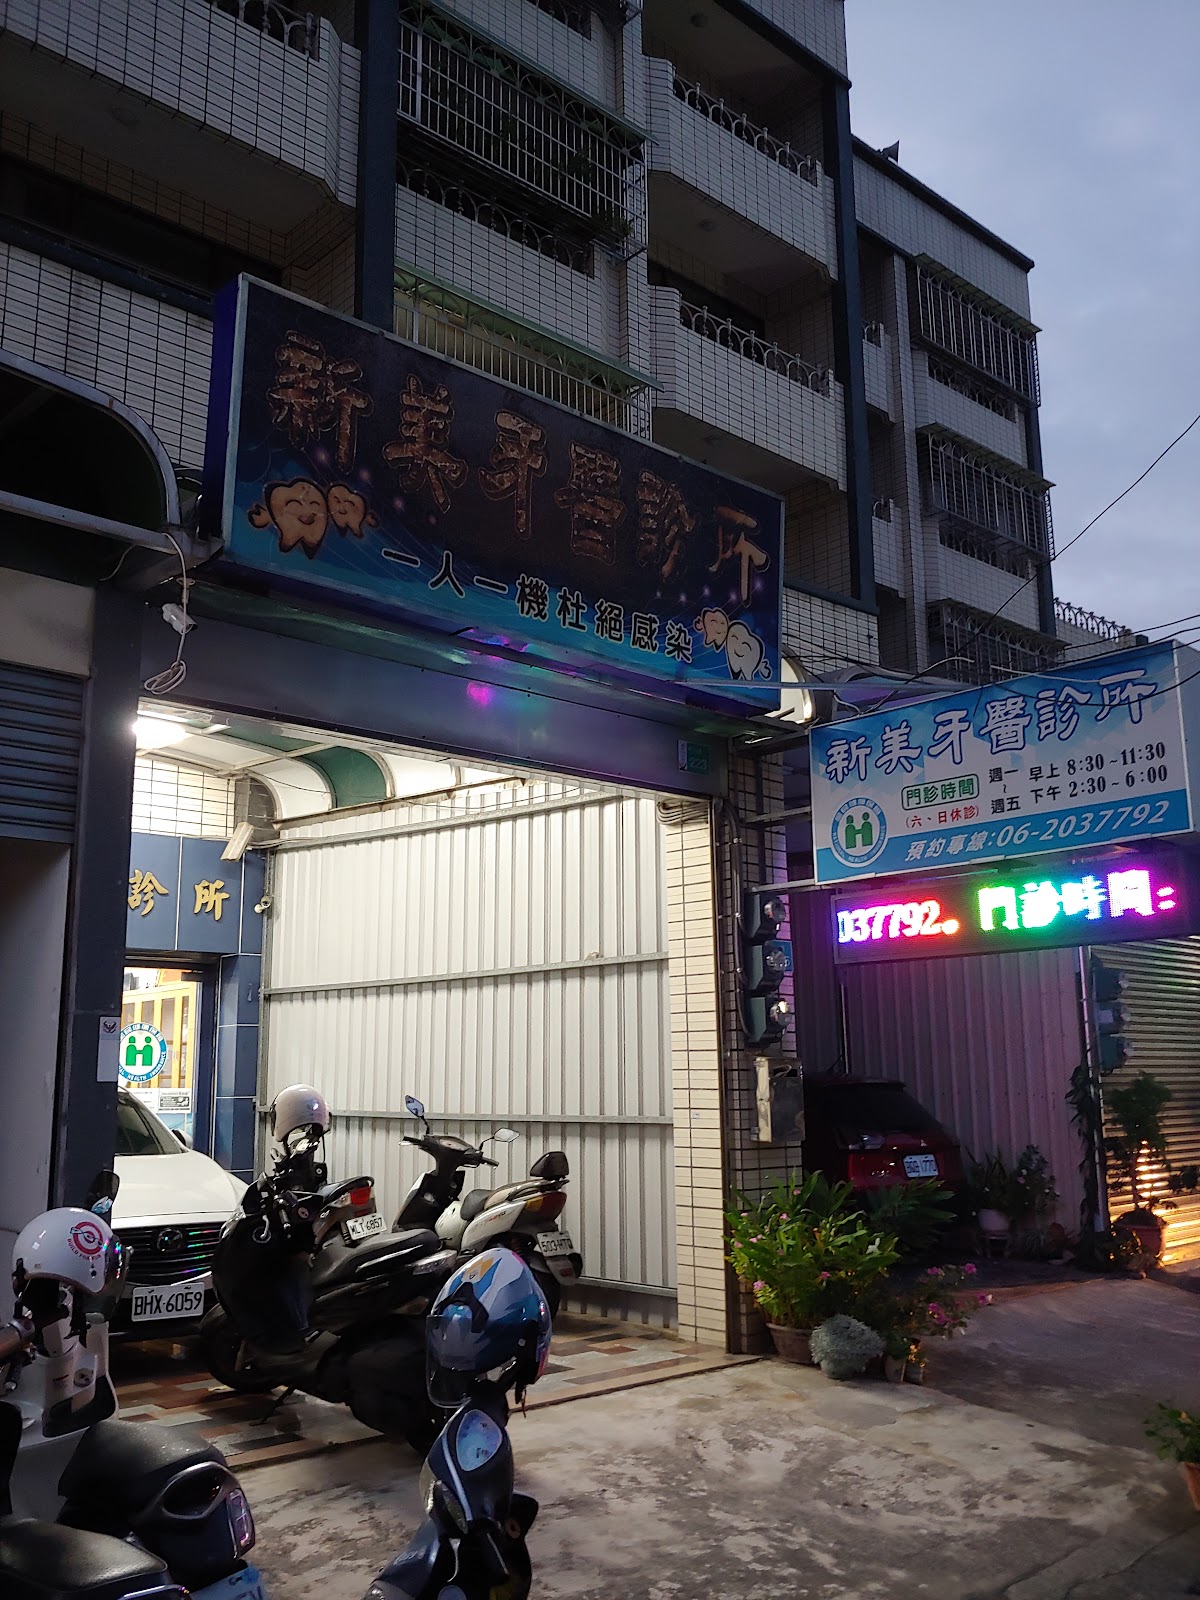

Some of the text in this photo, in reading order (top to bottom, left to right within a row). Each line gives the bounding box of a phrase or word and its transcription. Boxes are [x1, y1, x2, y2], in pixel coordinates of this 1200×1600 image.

[382, 548, 693, 663] 一人一機杜絕感染
[824, 667, 1159, 784] 新美牙醫診所
[988, 766, 1019, 784] 週一
[1028, 763, 1060, 782] 早上
[905, 778, 975, 807] 門診時間
[1030, 785, 1061, 804] 下午
[990, 796, 1021, 816] 週五
[128, 869, 230, 921] 診所
[133, 1291, 203, 1317] BHX-6059
